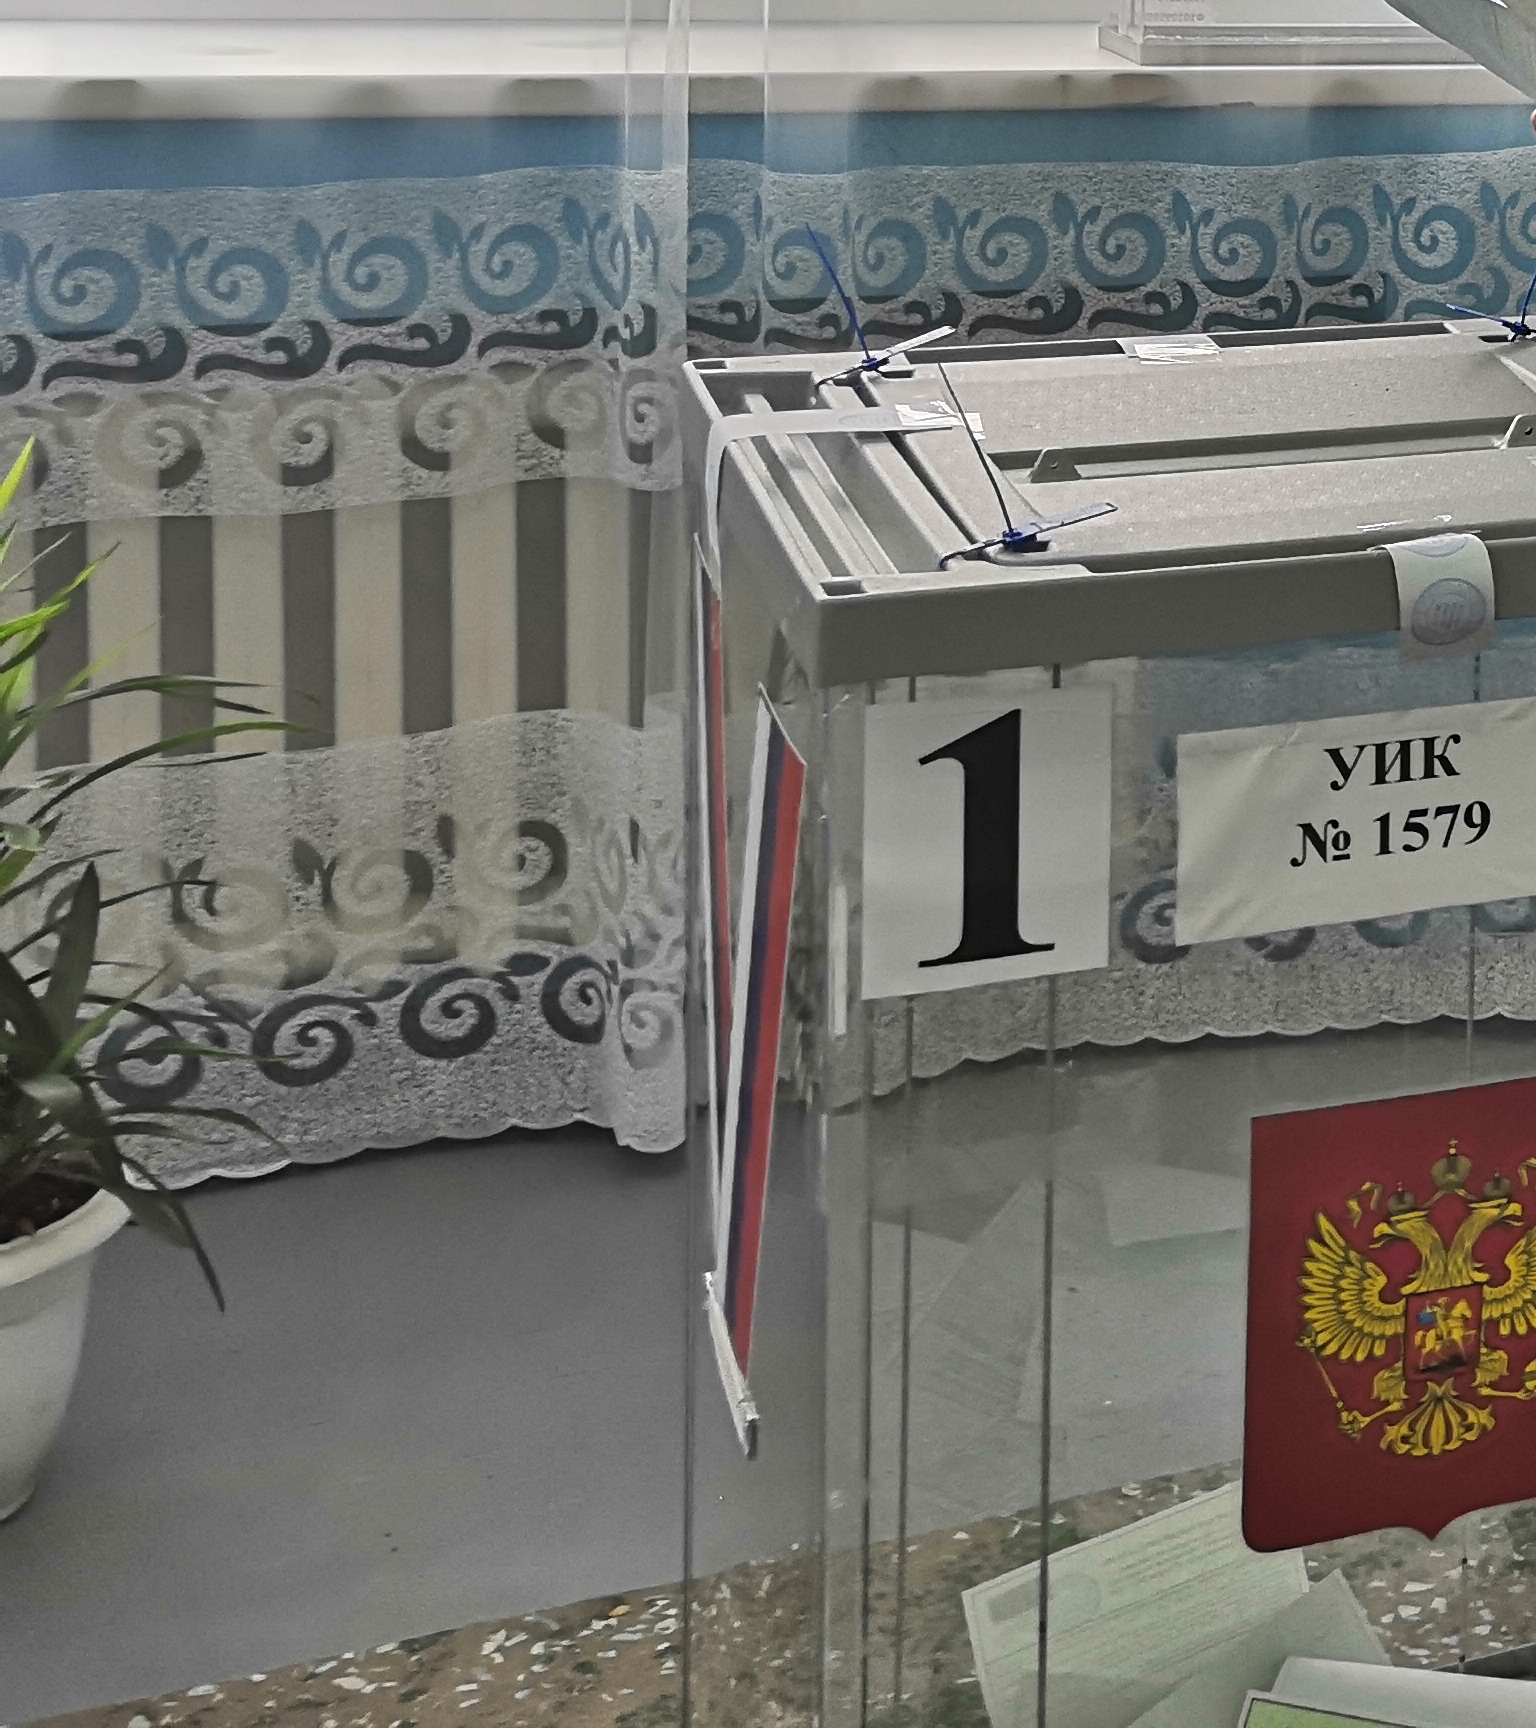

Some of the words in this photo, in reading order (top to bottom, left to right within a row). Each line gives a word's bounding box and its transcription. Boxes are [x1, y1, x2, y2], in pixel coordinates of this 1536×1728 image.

[1323, 733, 1462, 791] УИК
[918, 708, 1055, 968] 1
[1290, 819, 1351, 867] №
[1372, 800, 1491, 857] 1579
